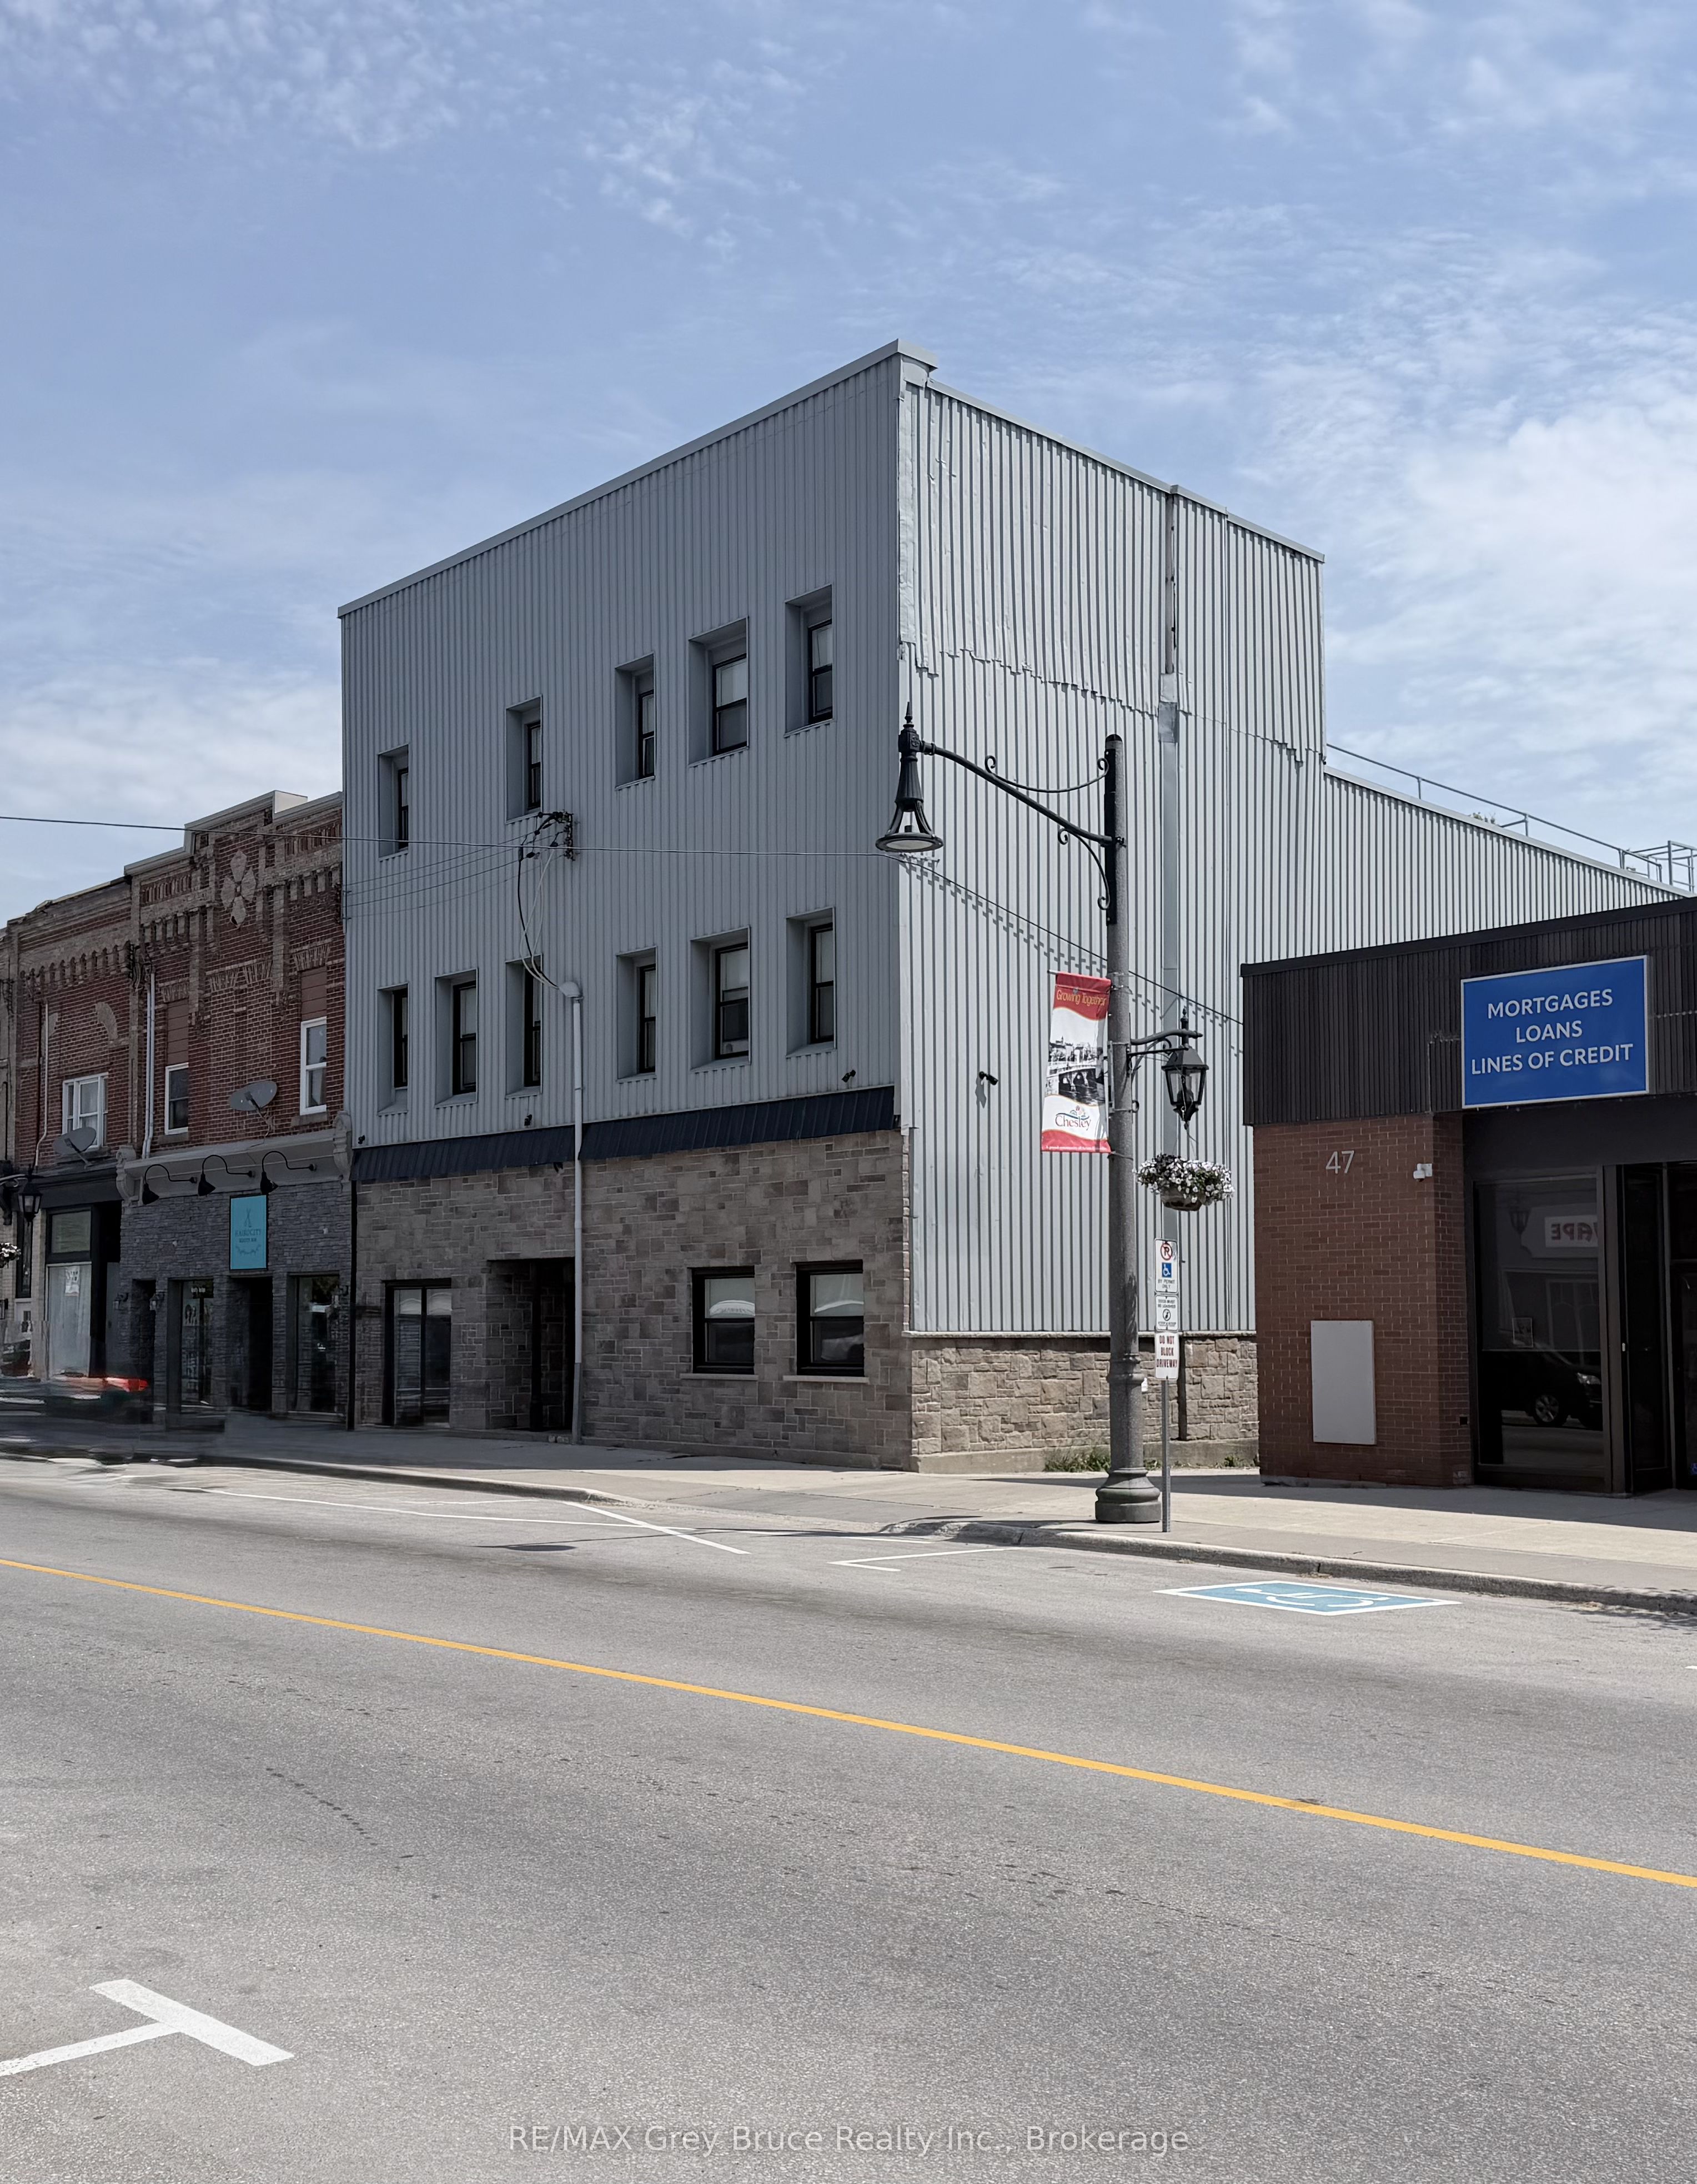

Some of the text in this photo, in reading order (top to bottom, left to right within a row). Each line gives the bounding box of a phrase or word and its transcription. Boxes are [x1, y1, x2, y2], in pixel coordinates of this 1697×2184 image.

[1056, 990, 1081, 1005] Growing
[1488, 988, 1613, 1018] MORTGAGES
[1516, 1020, 1582, 1043] LOANS
[1472, 1043, 1633, 1075] LINES OF CREDIT
[1055, 1115, 1091, 1131] Chesley
[1326, 1150, 1354, 1174] 47
[1159, 1335, 1165, 1344] DO
[1161, 1347, 1174, 1355] BLOCK
[1156, 1359, 1177, 1368] DRIVEWAY
